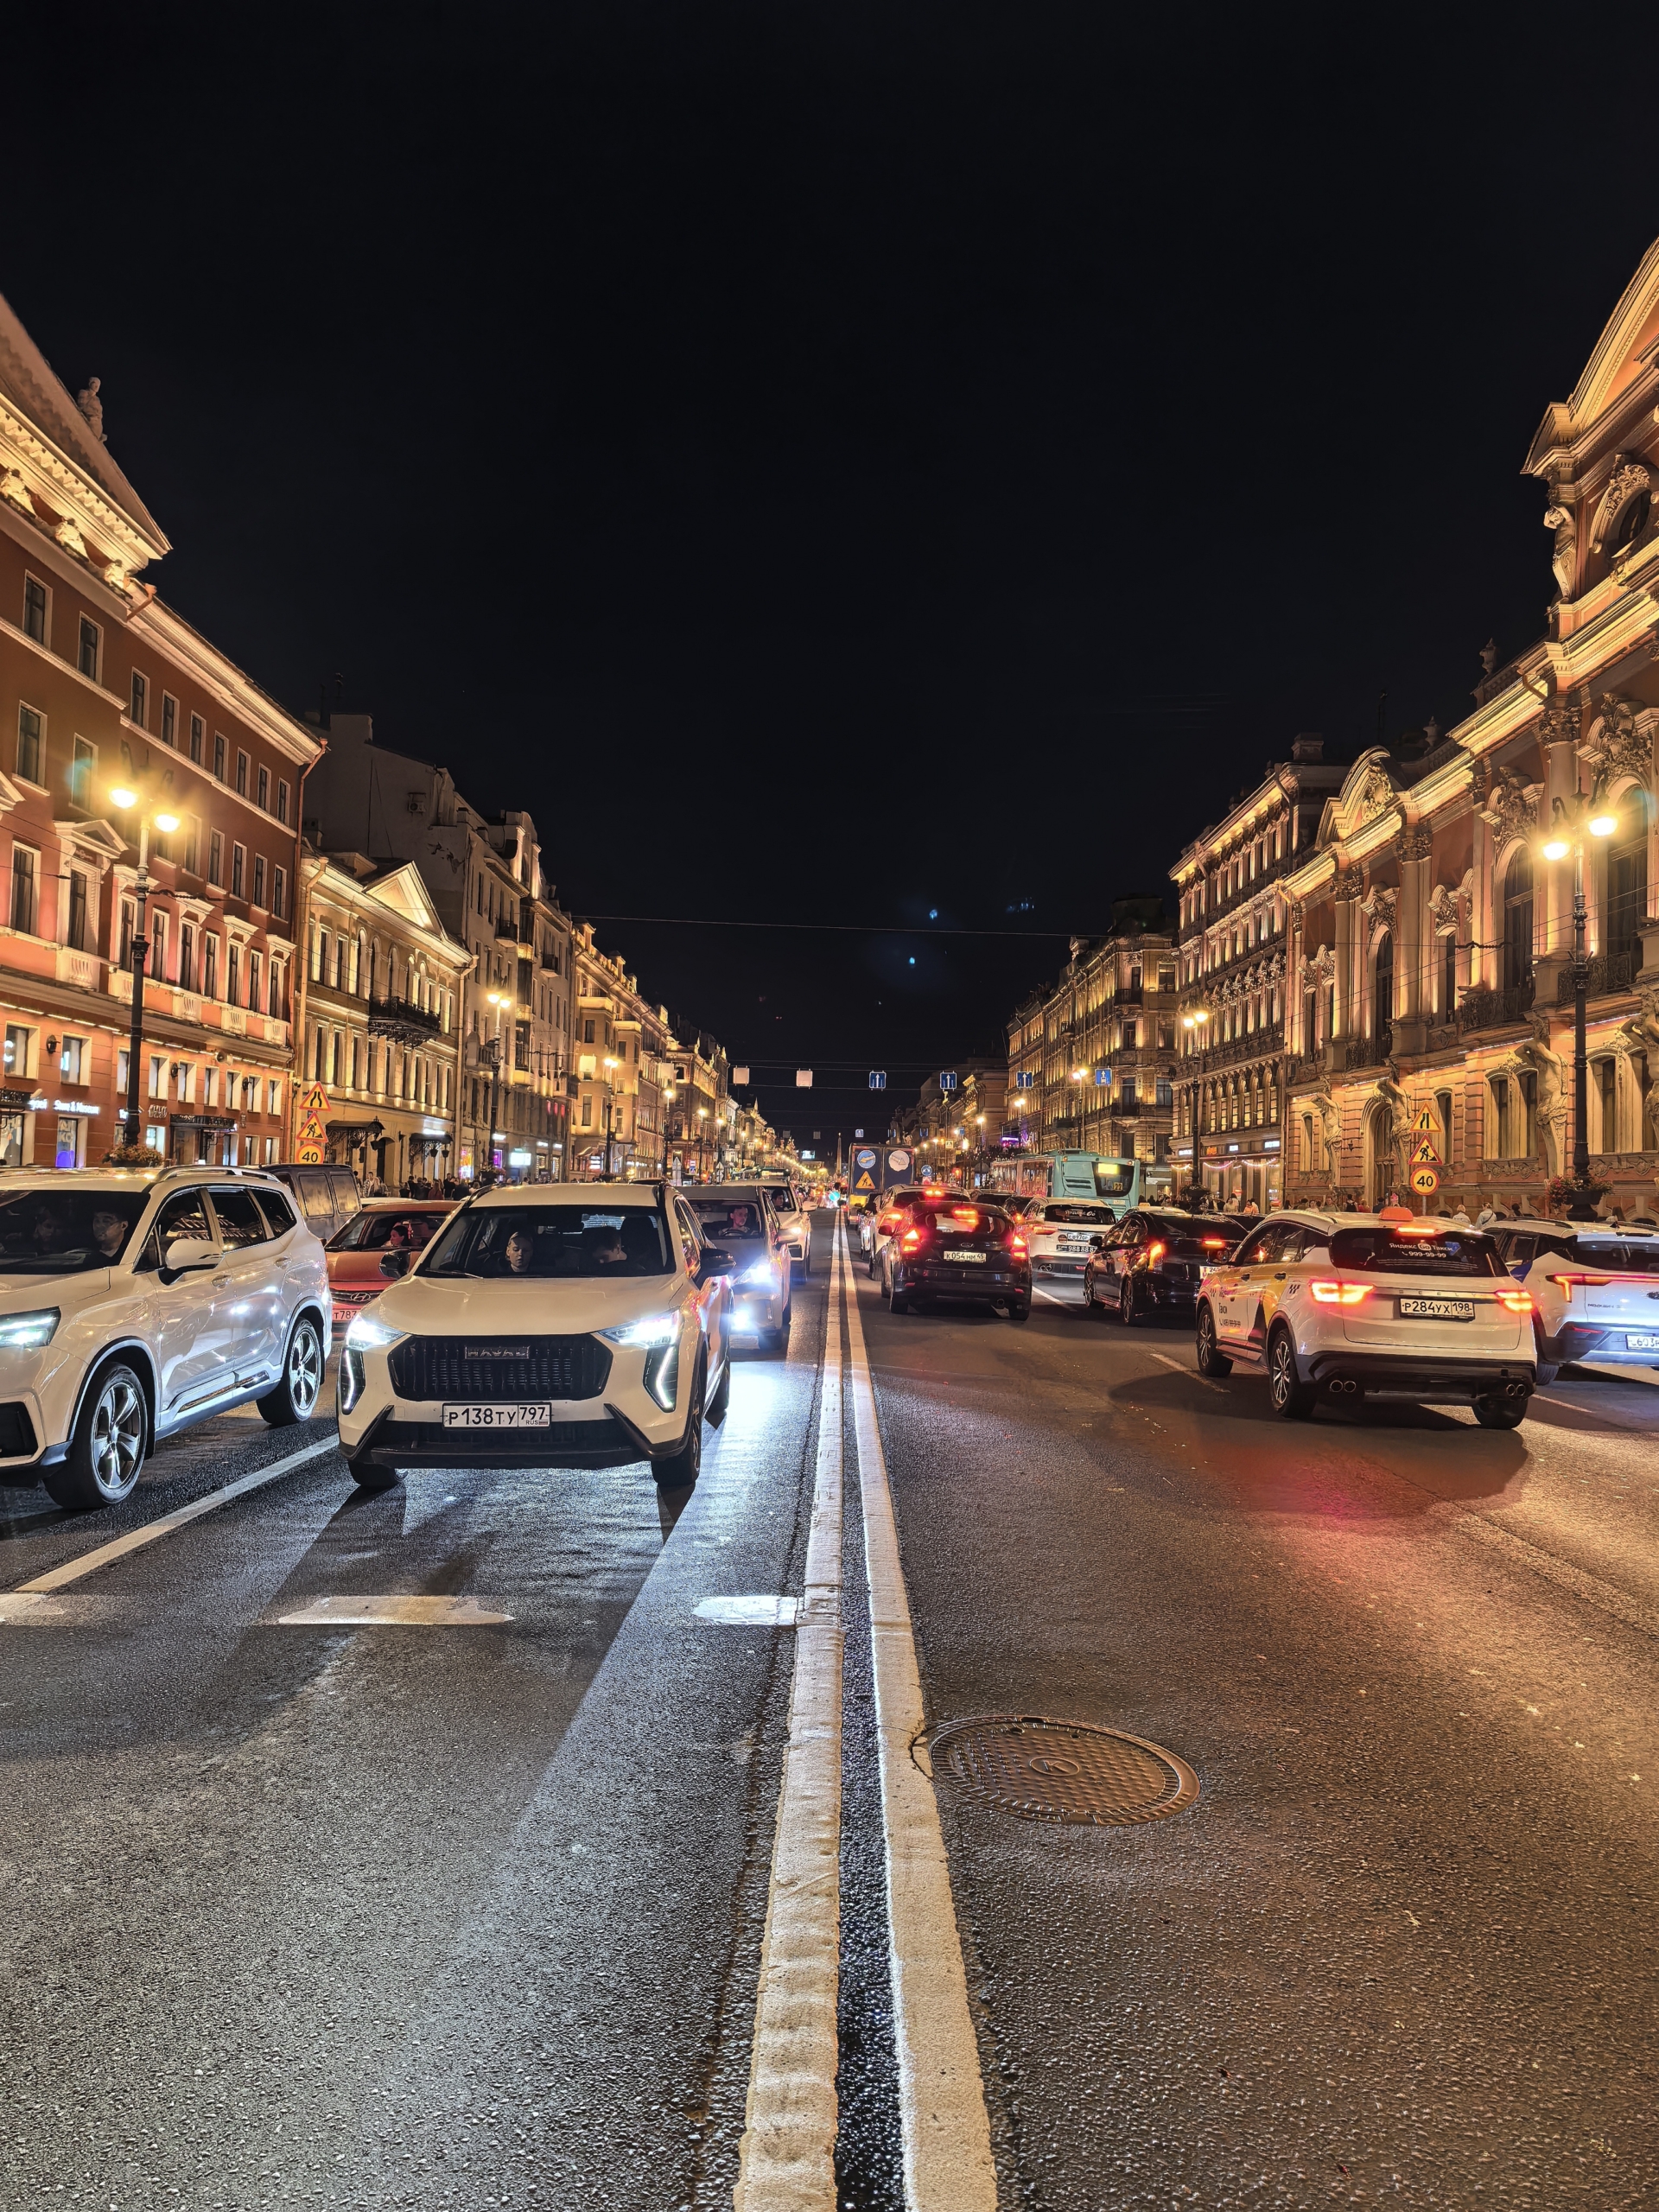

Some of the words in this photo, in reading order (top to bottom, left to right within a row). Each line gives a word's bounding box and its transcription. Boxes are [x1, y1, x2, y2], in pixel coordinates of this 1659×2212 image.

[302, 1152, 318, 1163] 40
[1417, 1176, 1433, 1187] 40
[1452, 1302, 1470, 1312] 198
[519, 1407, 546, 1420] 797
